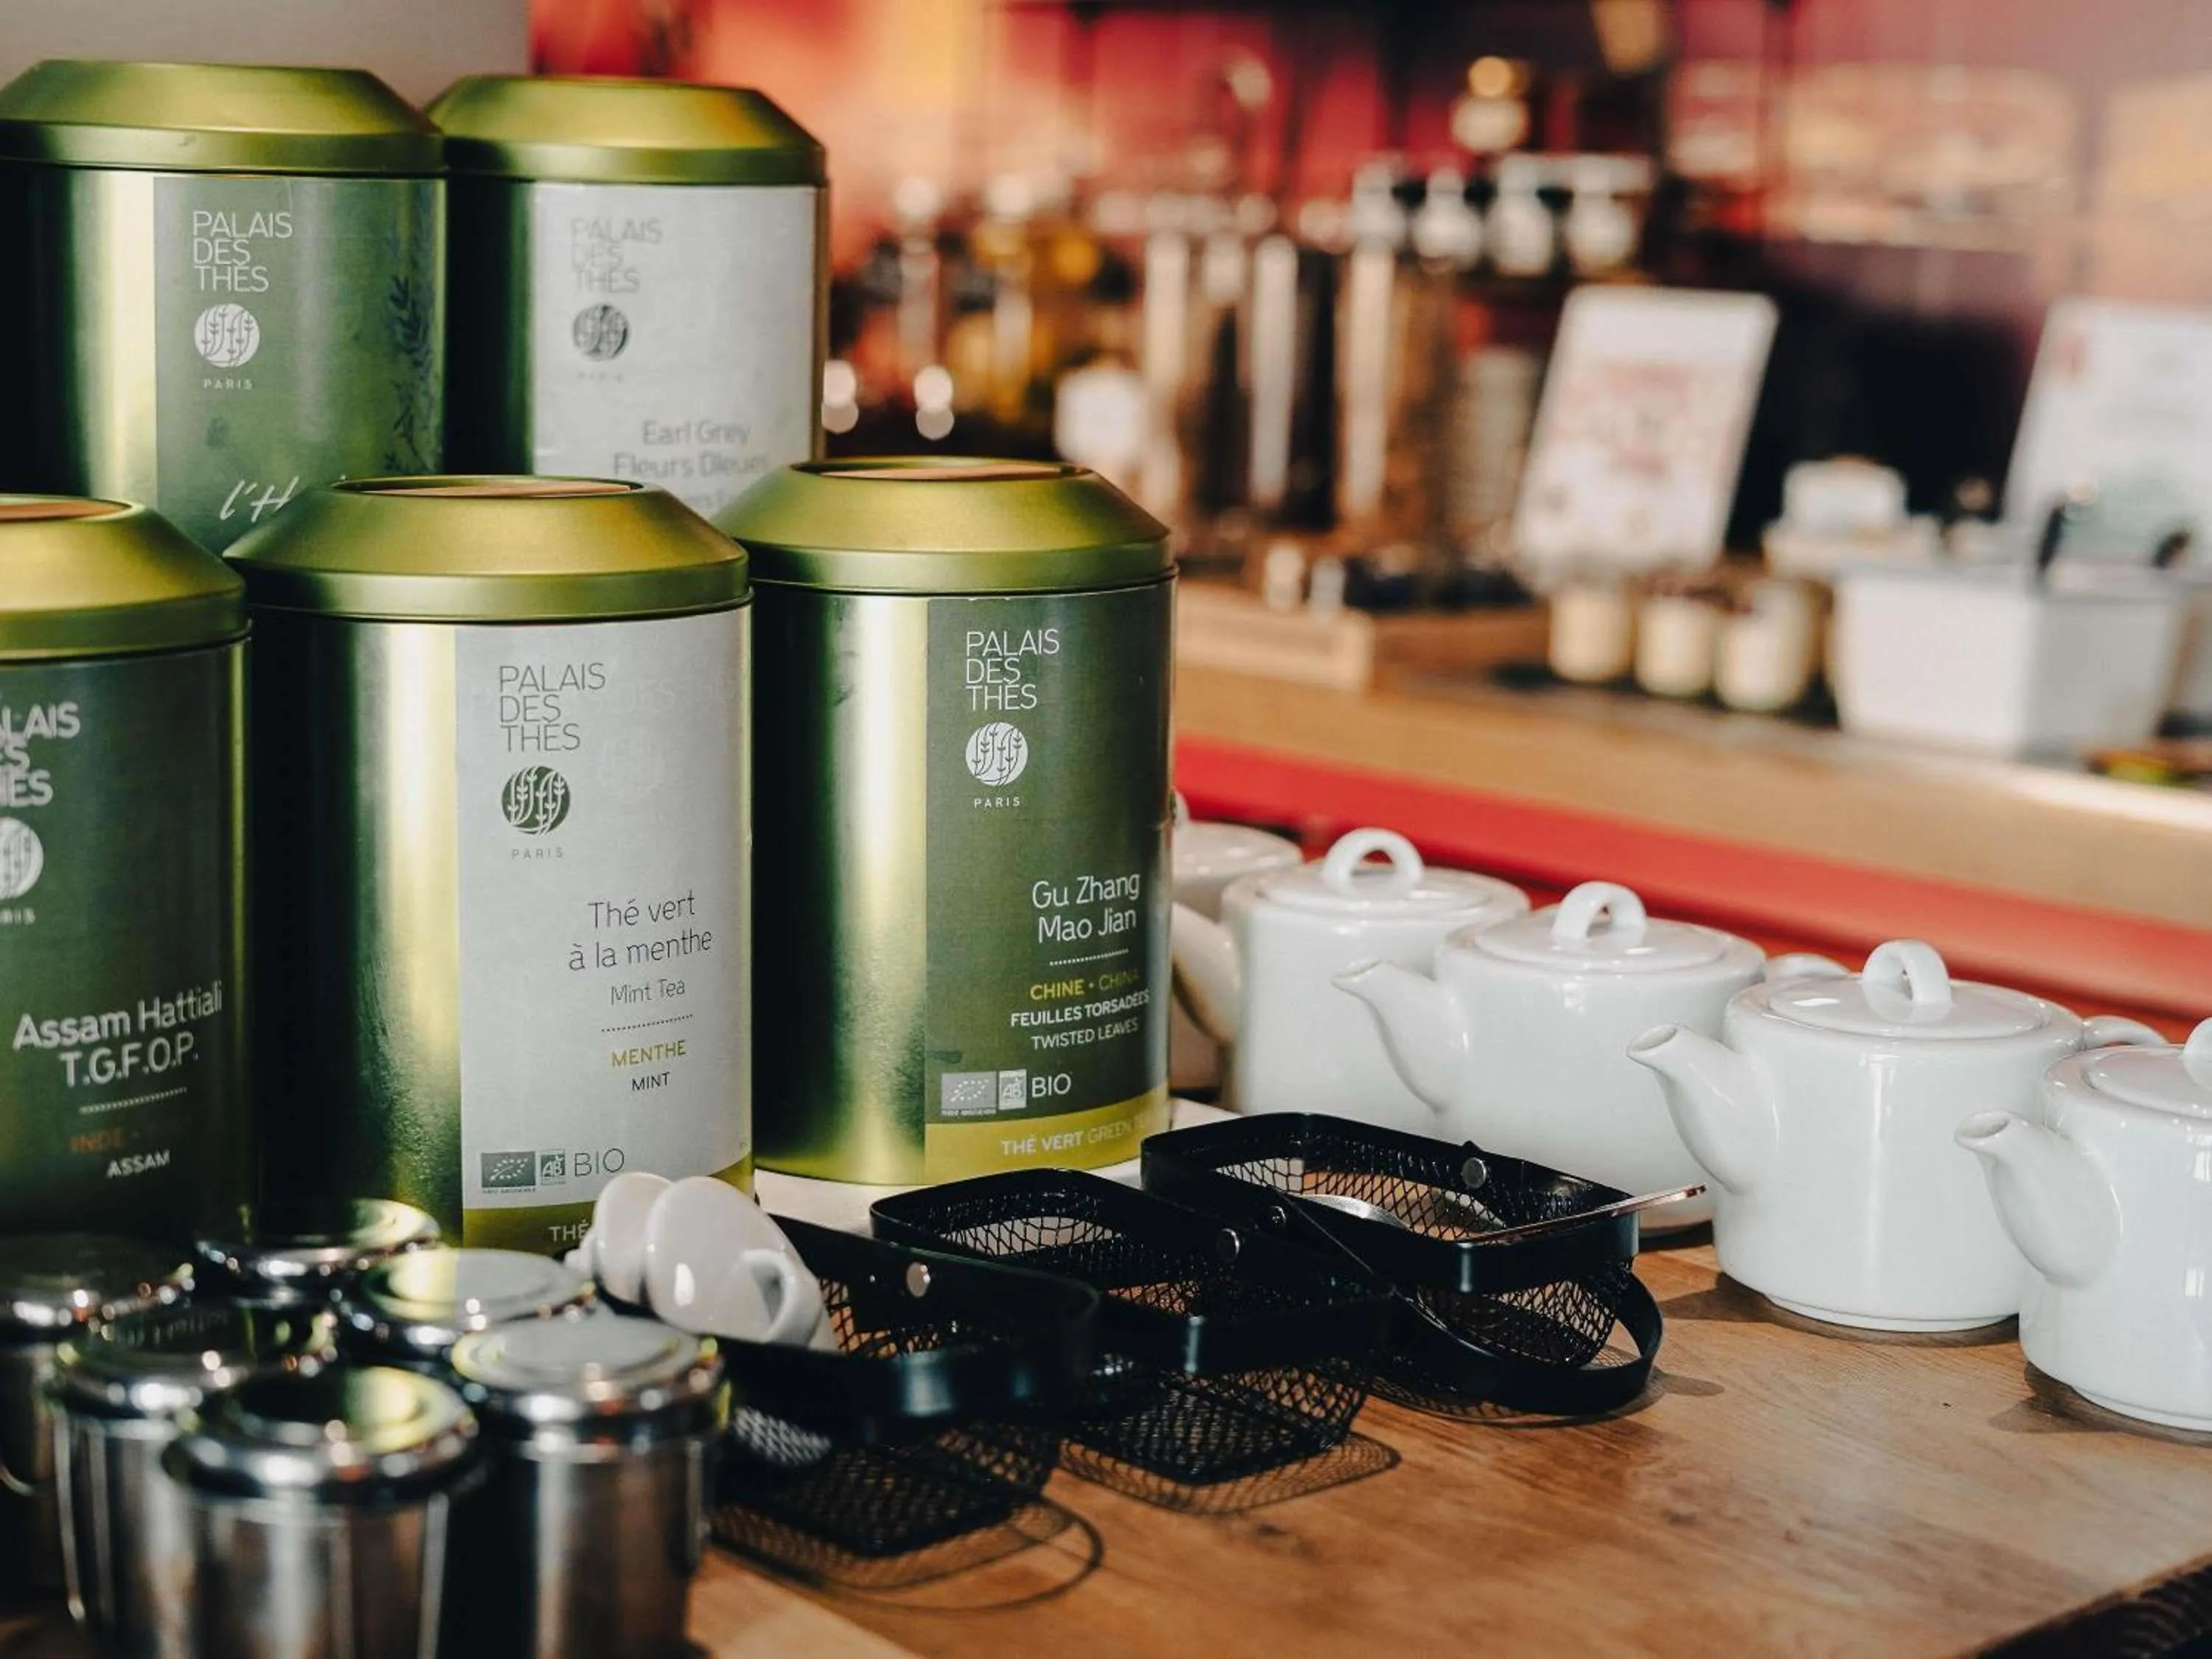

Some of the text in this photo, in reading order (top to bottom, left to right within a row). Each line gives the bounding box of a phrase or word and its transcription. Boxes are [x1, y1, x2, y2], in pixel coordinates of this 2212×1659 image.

[192, 211, 294, 239] PALAIS
[571, 217, 664, 244] PALAIS
[192, 237, 251, 265] DES
[203, 378, 254, 392] PARIS
[642, 419, 692, 445] Earl
[966, 627, 1060, 657] PALAIS
[498, 661, 606, 693] PALAIS
[966, 657, 1021, 684] DES
[0, 701, 81, 739] LAIS
[499, 693, 562, 724] DES
[973, 796, 1021, 809] PARIS
[511, 846, 564, 860] PARIS
[1032, 873, 1141, 909] Gu Zhang
[588, 888, 695, 929] Thé vert
[1037, 908, 1137, 944] Mao Jian
[568, 928, 713, 972] à la menthe
[611, 978, 686, 1006] Mint Tea
[1029, 978, 1085, 1001] CHINE
[12, 979, 223, 1052] Assam Hattiali
[1010, 1005, 1082, 1027] FEUILLES
[1030, 1017, 1140, 1050] TWISTED LEAVES
[611, 1039, 687, 1068] MENTHE
[631, 1071, 670, 1091] MINT
[1031, 1073, 1071, 1098] BIO
[1001, 1133, 1037, 1156] THÉ
[1041, 1130, 1084, 1152] VERT
[105, 1147, 171, 1180] ASSAM
[573, 1147, 625, 1178] BIO
